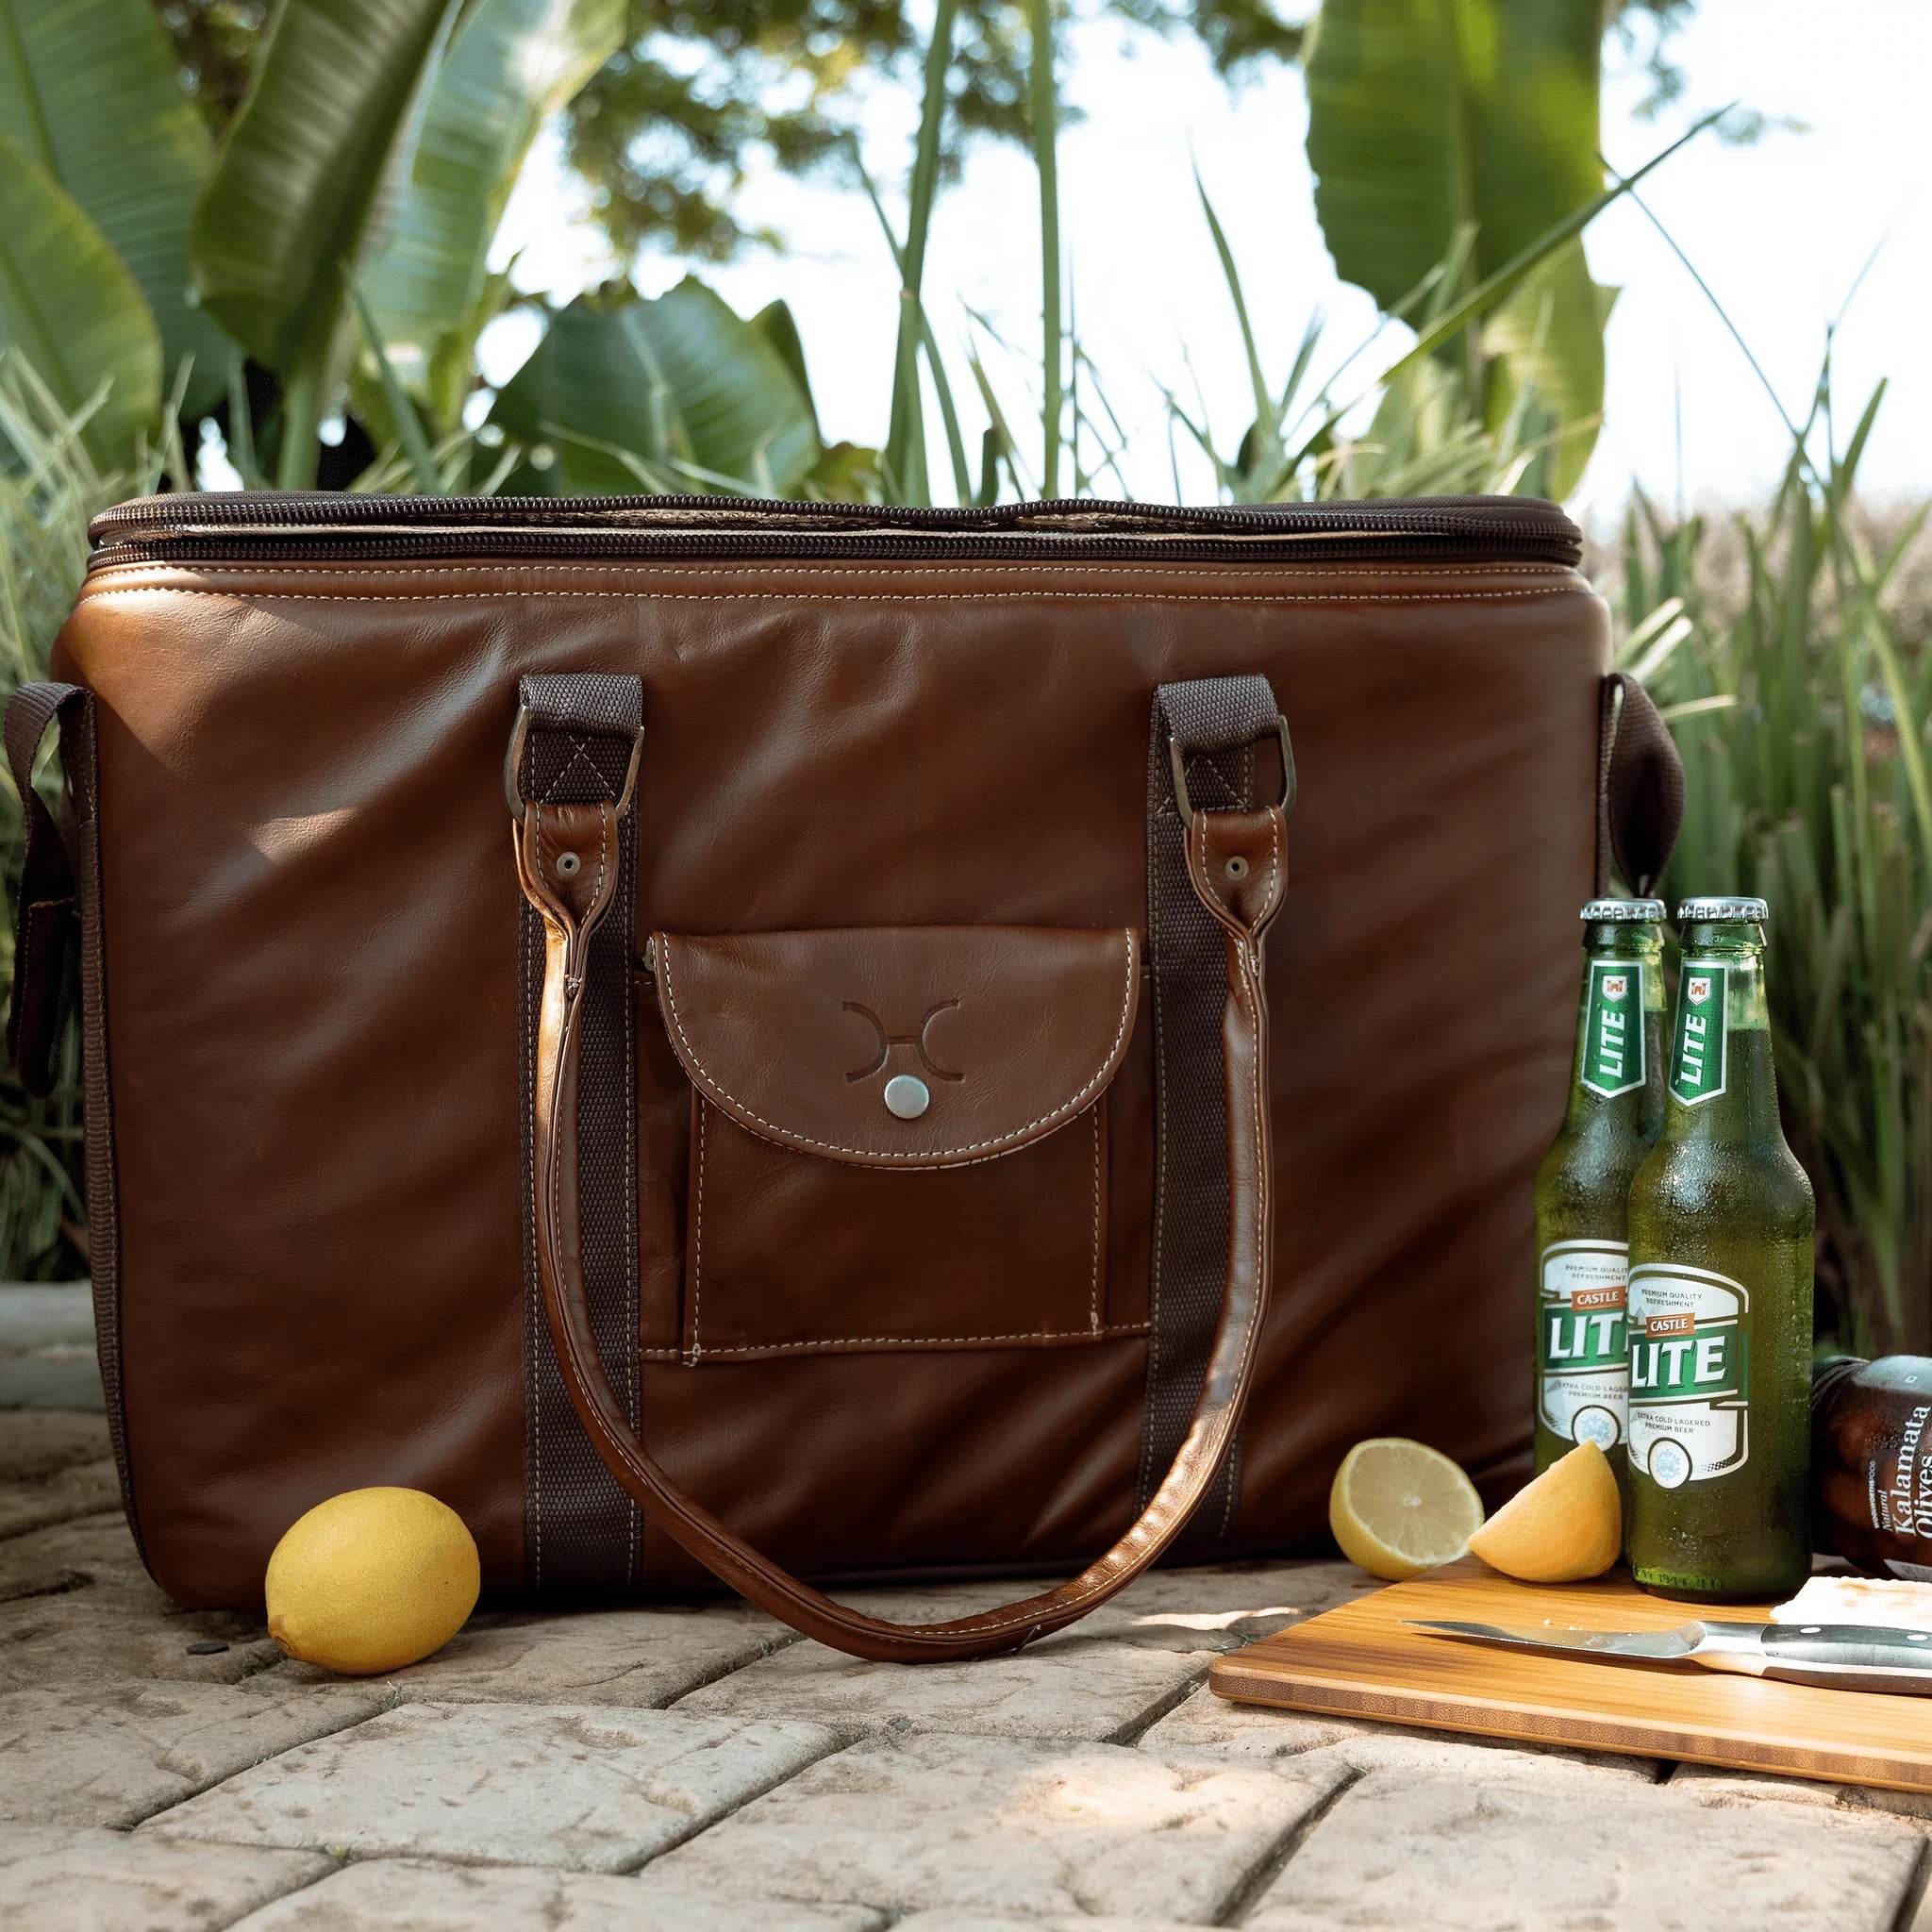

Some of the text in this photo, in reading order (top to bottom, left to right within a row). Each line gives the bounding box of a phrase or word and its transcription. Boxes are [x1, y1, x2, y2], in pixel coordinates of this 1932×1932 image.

[1599, 1009, 1624, 1078] LITE
[1680, 1013, 1707, 1087] LITE
[1566, 1264, 1598, 1273] PREMIUM
[1572, 1273, 1626, 1281] REFRESHMENT
[1576, 1291, 1620, 1306] CASTLE
[1641, 1289, 1703, 1301] PREMIUM QUALITY
[1646, 1298, 1694, 1307] REFRESHMENT
[1650, 1319, 1689, 1332] CASTLE
[1549, 1311, 1628, 1359] LIT
[1631, 1336, 1726, 1389] LITE
[1581, 1383, 1601, 1391] COLD
[1638, 1411, 1711, 1426] EXTRA COLD LAGERED
[1645, 1422, 1673, 1432] PREMIUM
[1890, 1406, 1931, 1537] Kalamata
[1914, 1456, 1932, 1539] Olives
[1877, 1489, 1893, 1532] Natural
